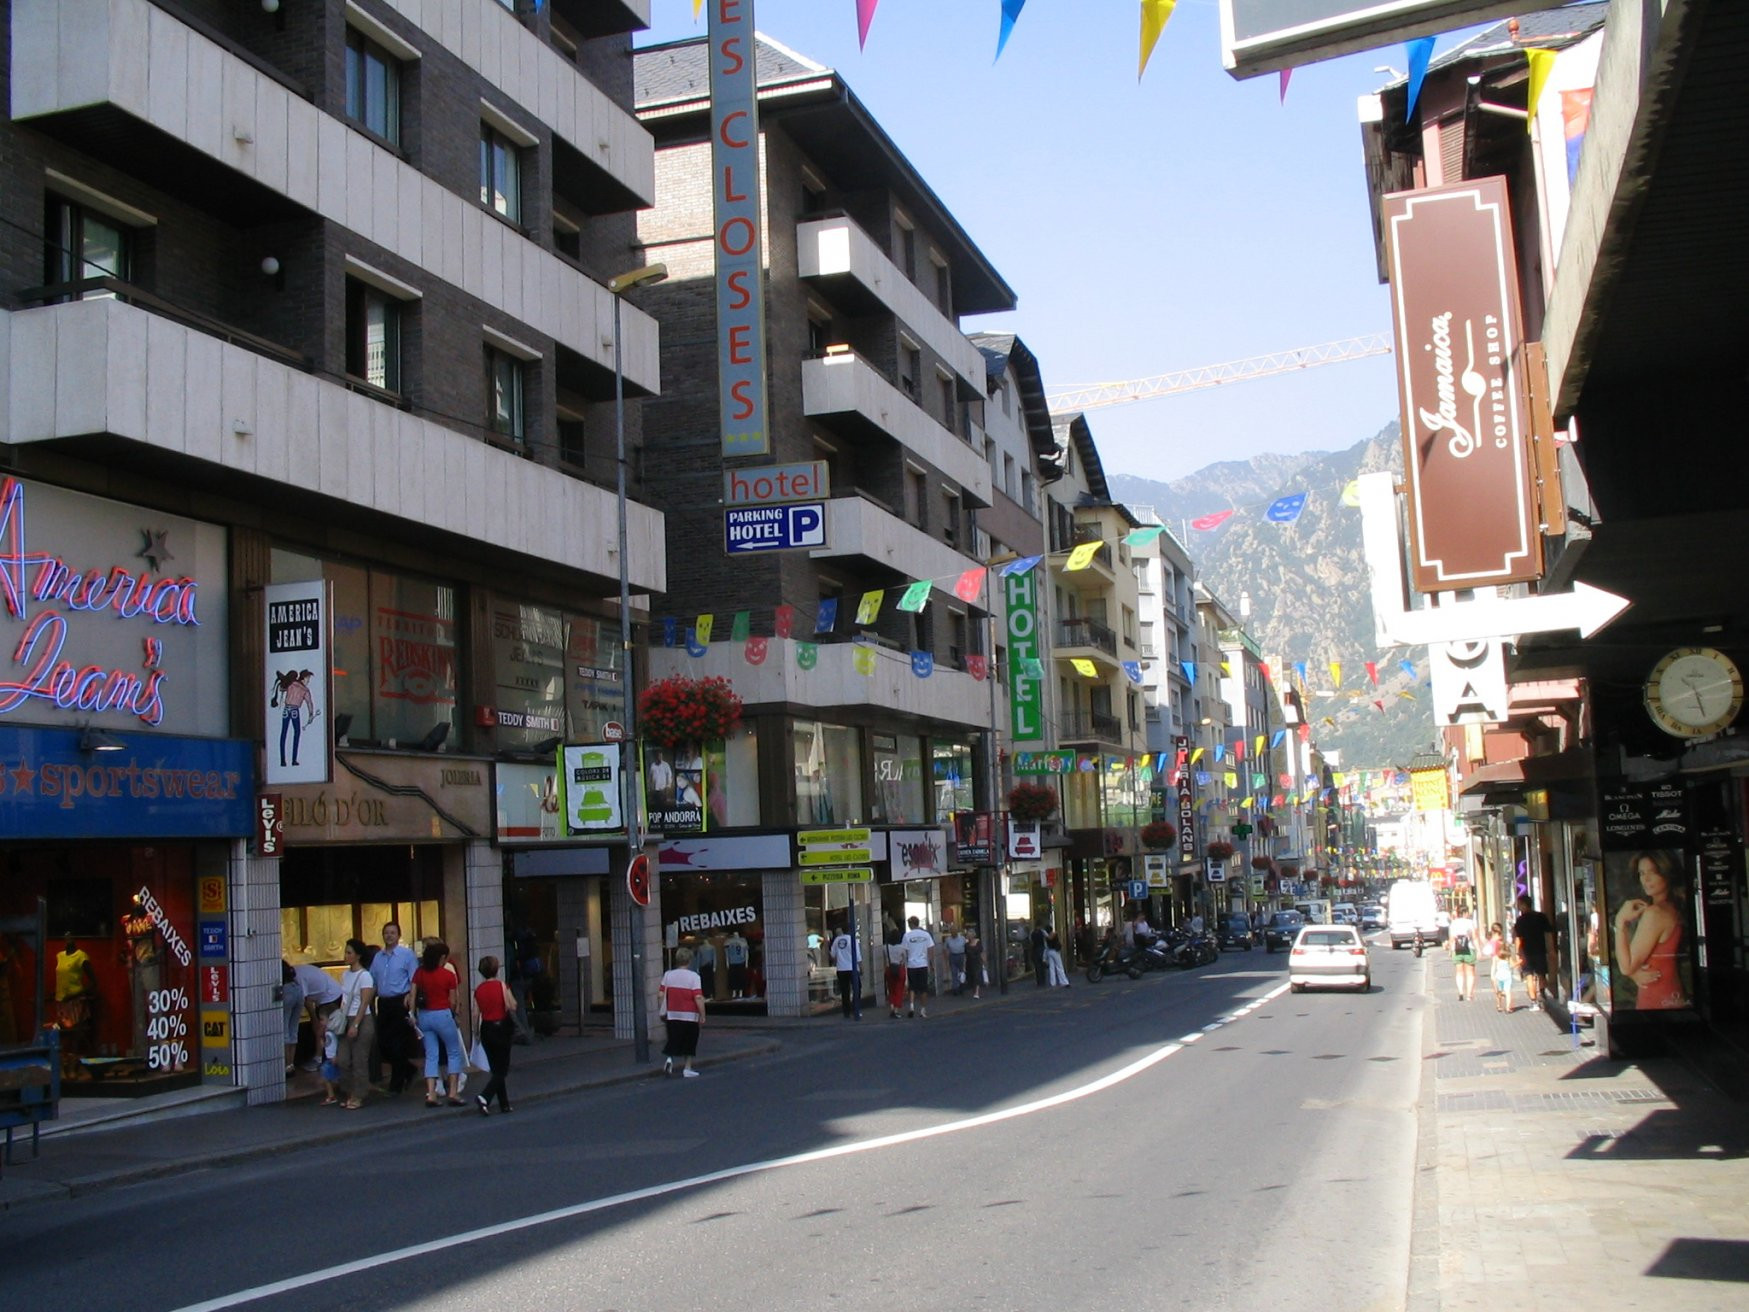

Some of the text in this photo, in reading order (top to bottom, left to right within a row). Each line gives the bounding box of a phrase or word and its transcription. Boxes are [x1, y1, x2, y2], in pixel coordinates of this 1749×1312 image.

[720, 111, 755, 420] CLOSES
[1419, 311, 1473, 459] Jamaica
[1486, 314, 1508, 449] COFFEE SHOP
[730, 463, 818, 501] hotel
[729, 508, 783, 523] PARKING
[792, 509, 820, 543] P
[730, 523, 783, 541] HOTEL
[0, 477, 201, 627] America
[271, 602, 319, 624] AMERICA
[276, 626, 313, 648] JEAN'S
[0, 608, 168, 727] Jean's
[1009, 576, 1036, 734] HOTEL
[498, 711, 523, 726] TEDDY
[526, 715, 549, 729] SMITH
[41, 756, 240, 809] sportswear
[1651, 790, 1684, 798] TISSOT
[648, 812, 662, 823] POP
[1608, 811, 1641, 821] OMEGA
[1133, 882, 1143, 897] P
[138, 885, 191, 967] REBAIXES
[679, 906, 756, 933] REBAIXES
[149, 986, 189, 1014] 30%
[147, 1013, 187, 1041] 40%
[204, 1021, 224, 1037] CAT
[148, 1040, 189, 1069] 50%
[204, 1061, 230, 1076] Lois
